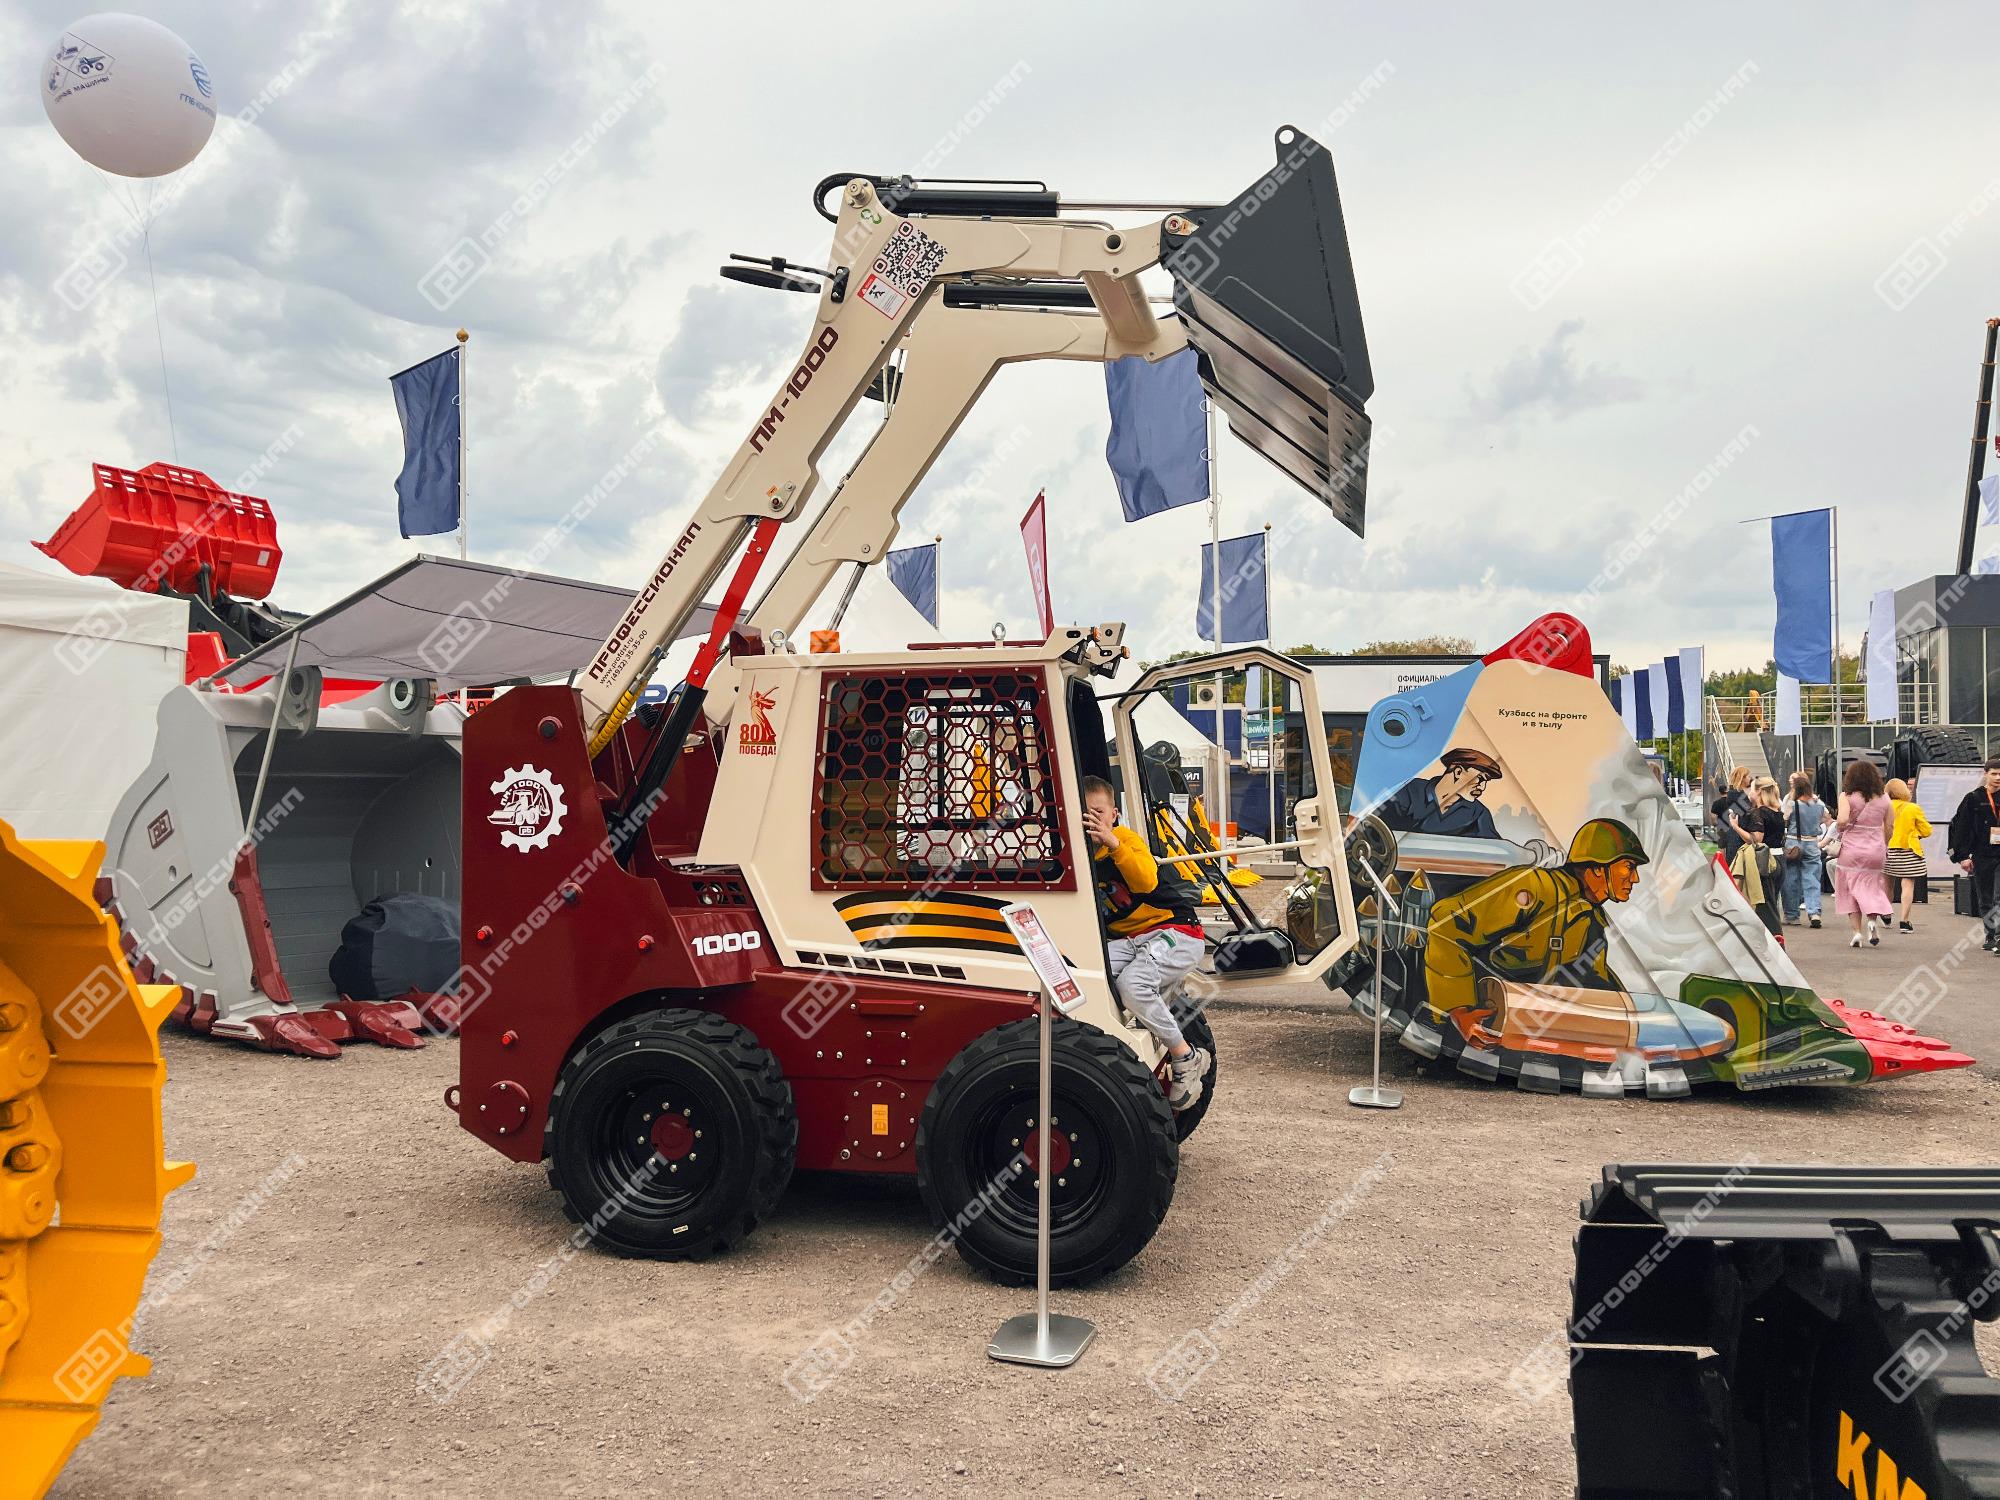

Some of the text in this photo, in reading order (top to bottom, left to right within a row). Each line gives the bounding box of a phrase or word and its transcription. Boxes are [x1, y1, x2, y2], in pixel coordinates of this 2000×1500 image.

[749, 326, 839, 454] ПМ-1000
[588, 521, 702, 680] ПРОФЕССИОНАЛ
[599, 637, 634, 685] www.profdst.ru
[611, 658, 628, 682] (4932)
[627, 629, 648, 661] 35-35-00
[1498, 708, 1536, 718] Кузбасс
[1552, 712, 1588, 720] фронте
[1539, 721, 1563, 730] тылу
[740, 723, 760, 742] 80
[739, 745, 777, 757] ПОБЕДА!
[500, 780, 541, 806] ПМ-1000
[691, 930, 761, 957] 1000
